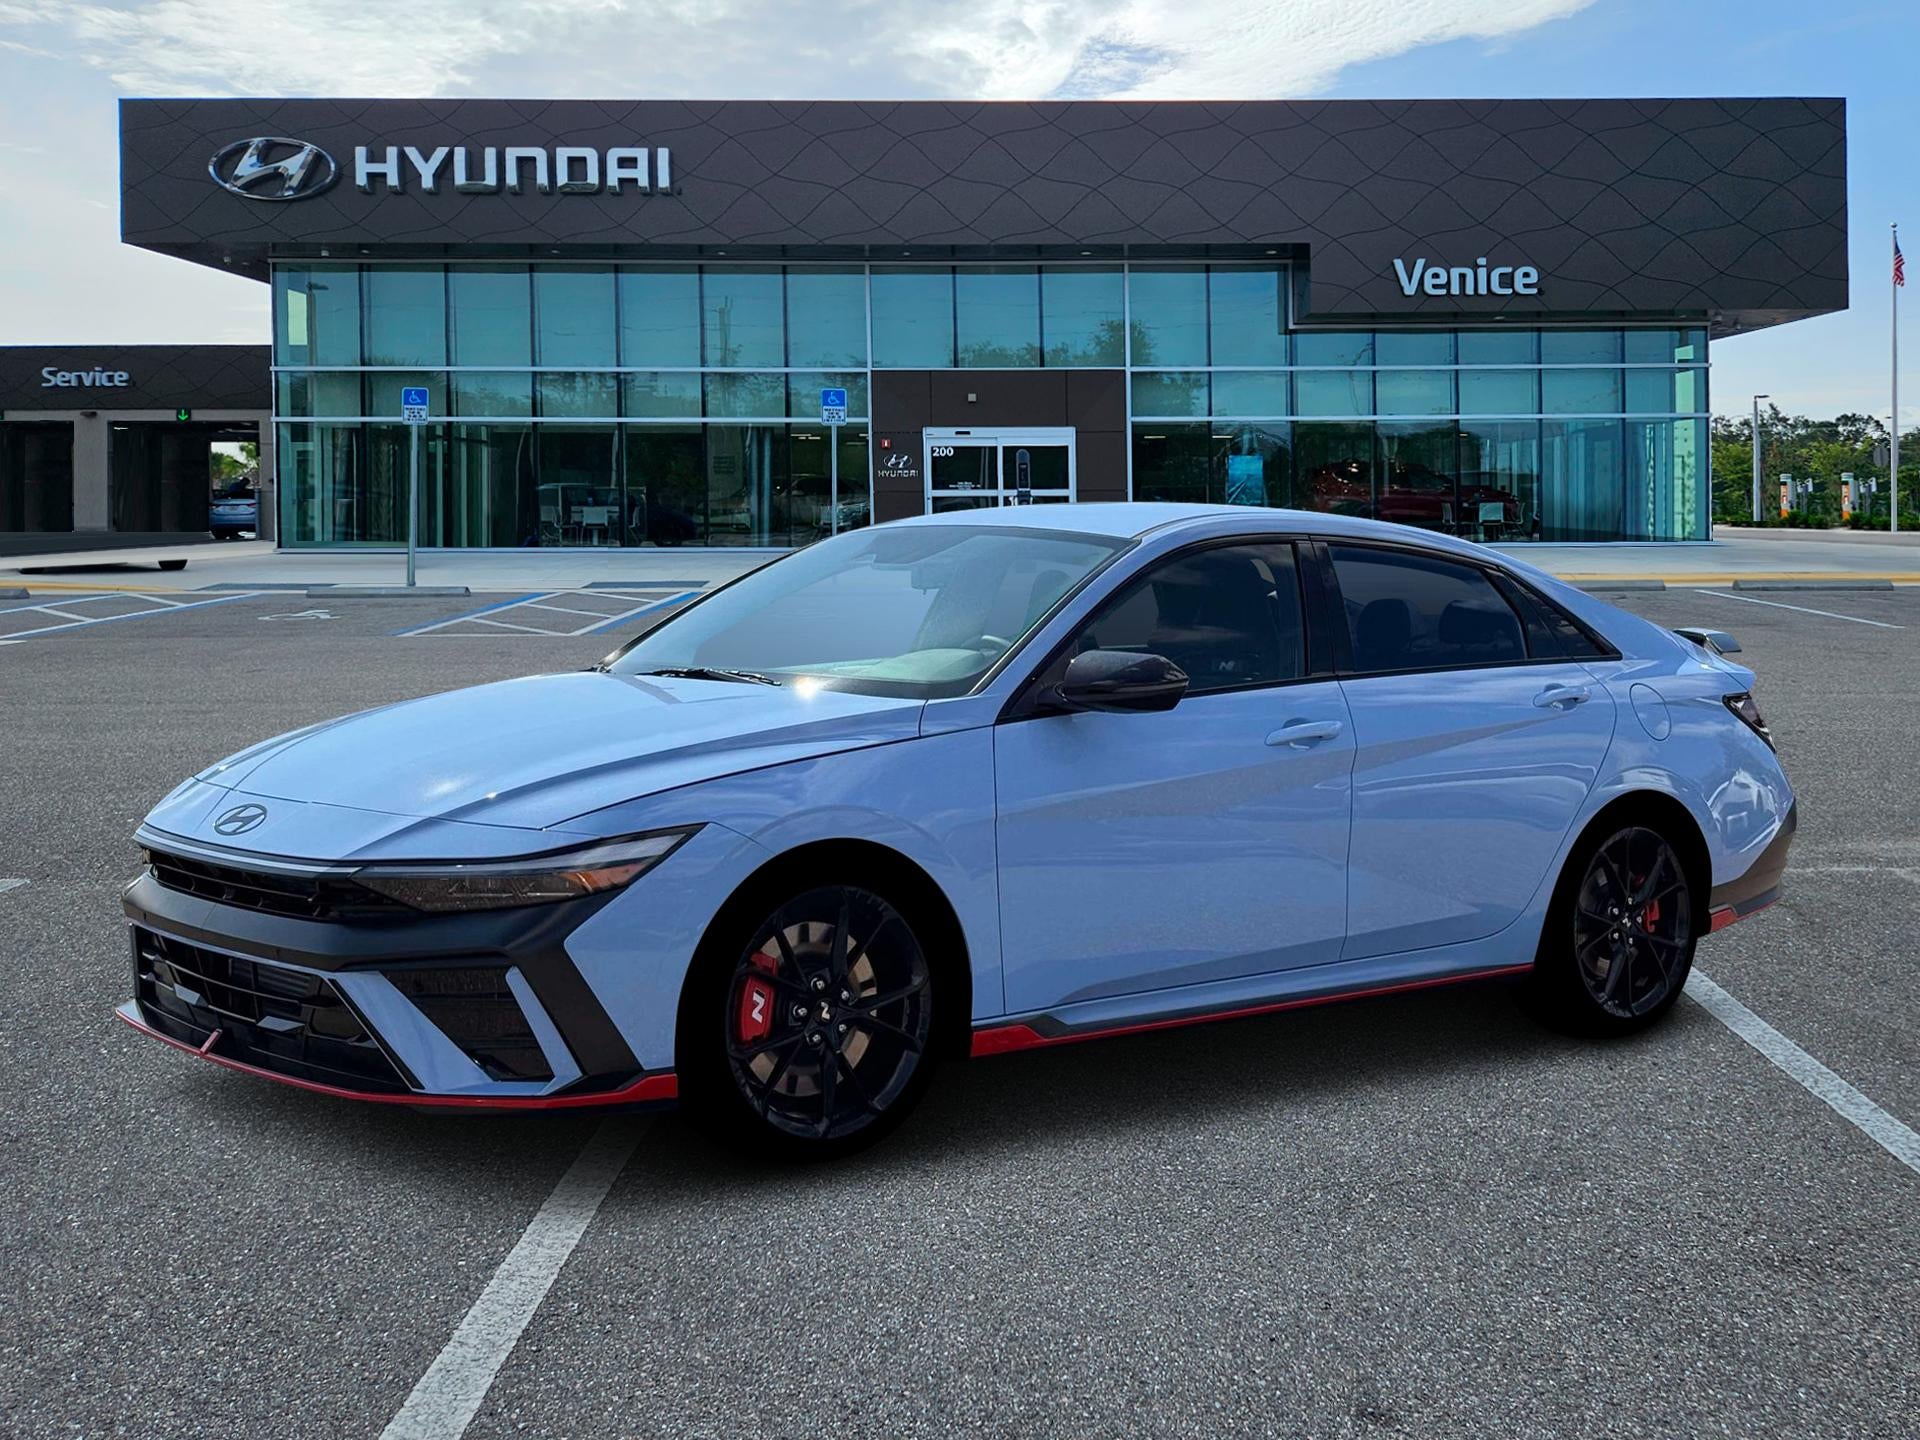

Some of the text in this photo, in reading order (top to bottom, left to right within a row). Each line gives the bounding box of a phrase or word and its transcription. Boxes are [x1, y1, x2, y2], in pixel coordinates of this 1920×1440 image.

[354, 146, 671, 194] HYUNDAI
[1393, 257, 1539, 296] Venice
[41, 366, 129, 387] Service
[932, 446, 954, 457] 200
